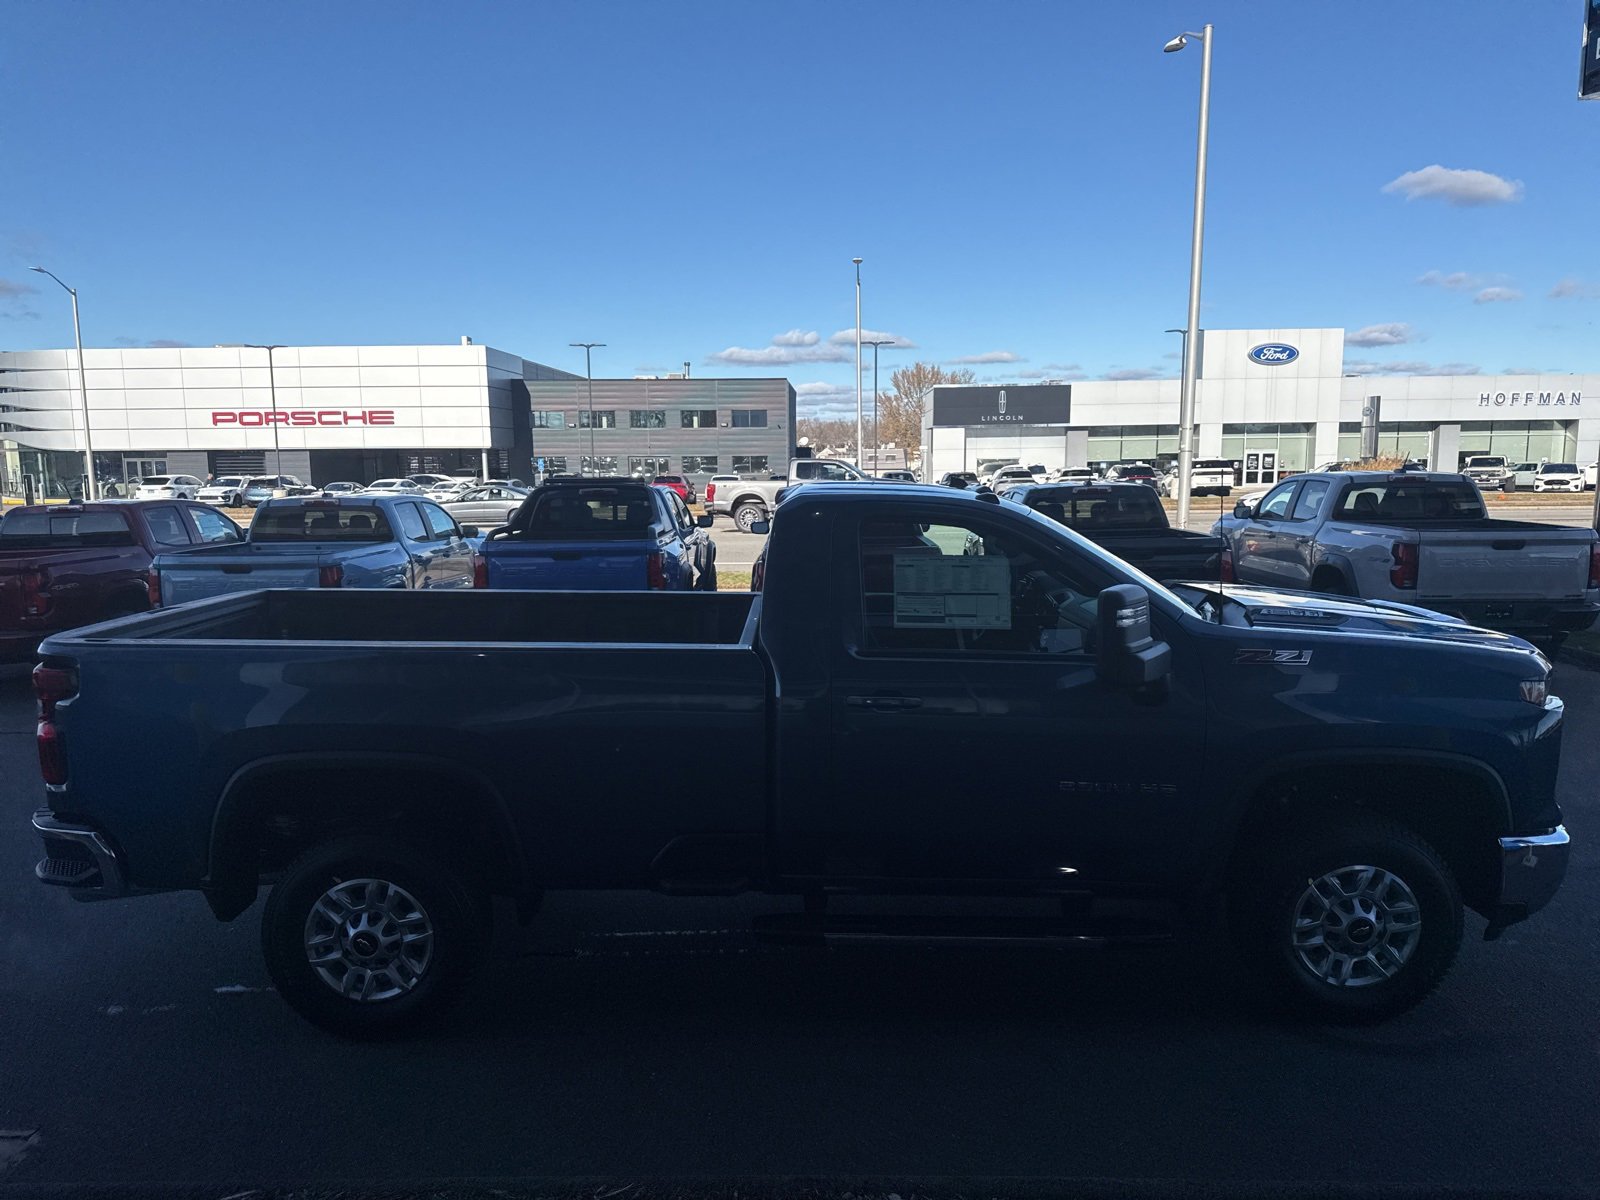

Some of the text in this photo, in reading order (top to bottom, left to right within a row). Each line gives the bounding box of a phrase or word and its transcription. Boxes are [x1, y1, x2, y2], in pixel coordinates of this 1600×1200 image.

[1260, 347, 1290, 360] Ford
[1480, 392, 1581, 405] HOFFMAN
[212, 410, 395, 426] PORSCHE
